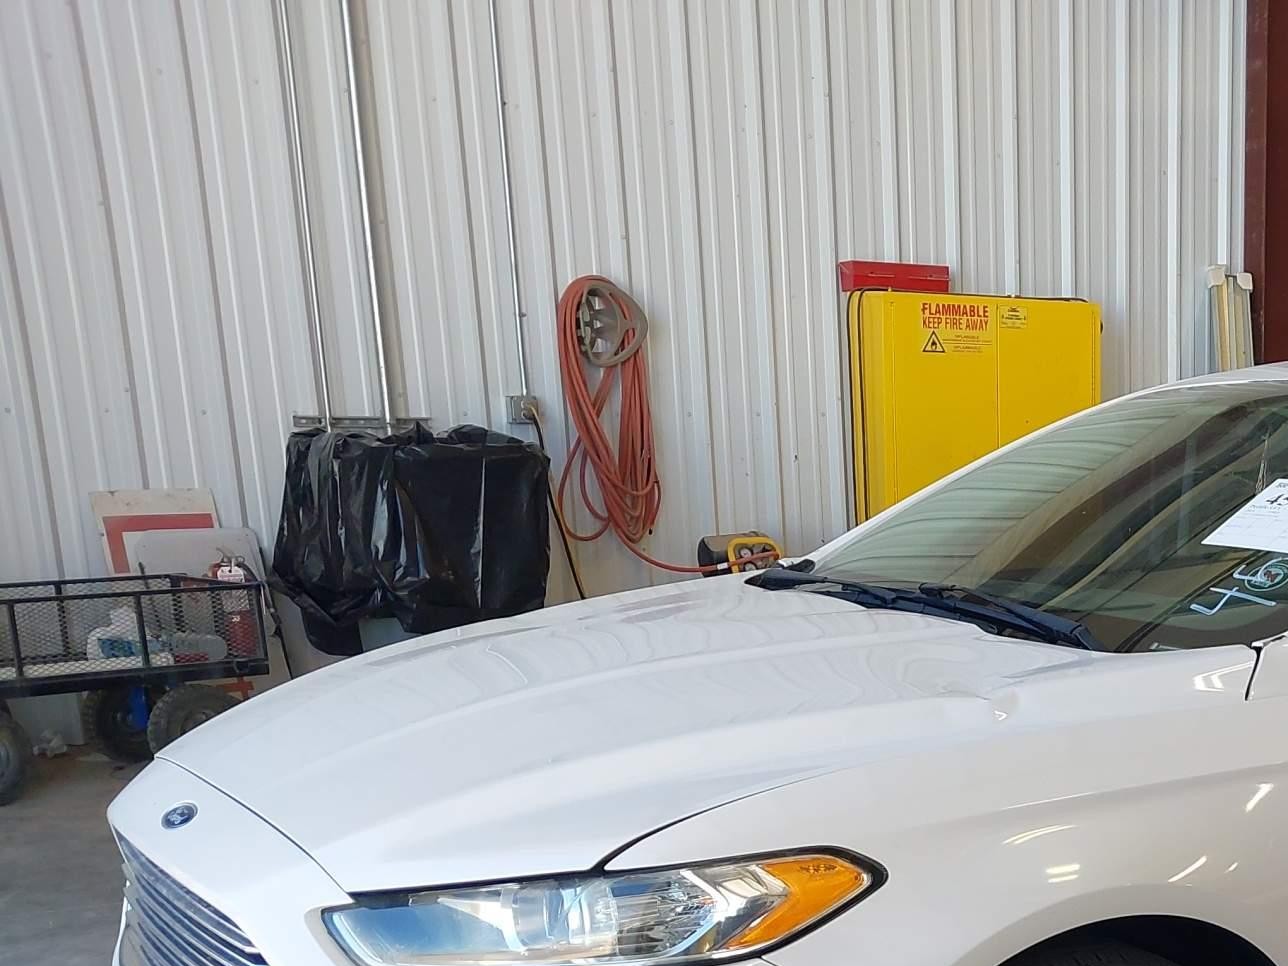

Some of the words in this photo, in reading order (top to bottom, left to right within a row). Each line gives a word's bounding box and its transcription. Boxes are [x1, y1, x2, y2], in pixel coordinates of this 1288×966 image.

[921, 302, 989, 318] FLAMMABLE
[922, 316, 943, 329] KEEP
[945, 318, 963, 330] FIRE
[965, 319, 989, 332] AWAY
